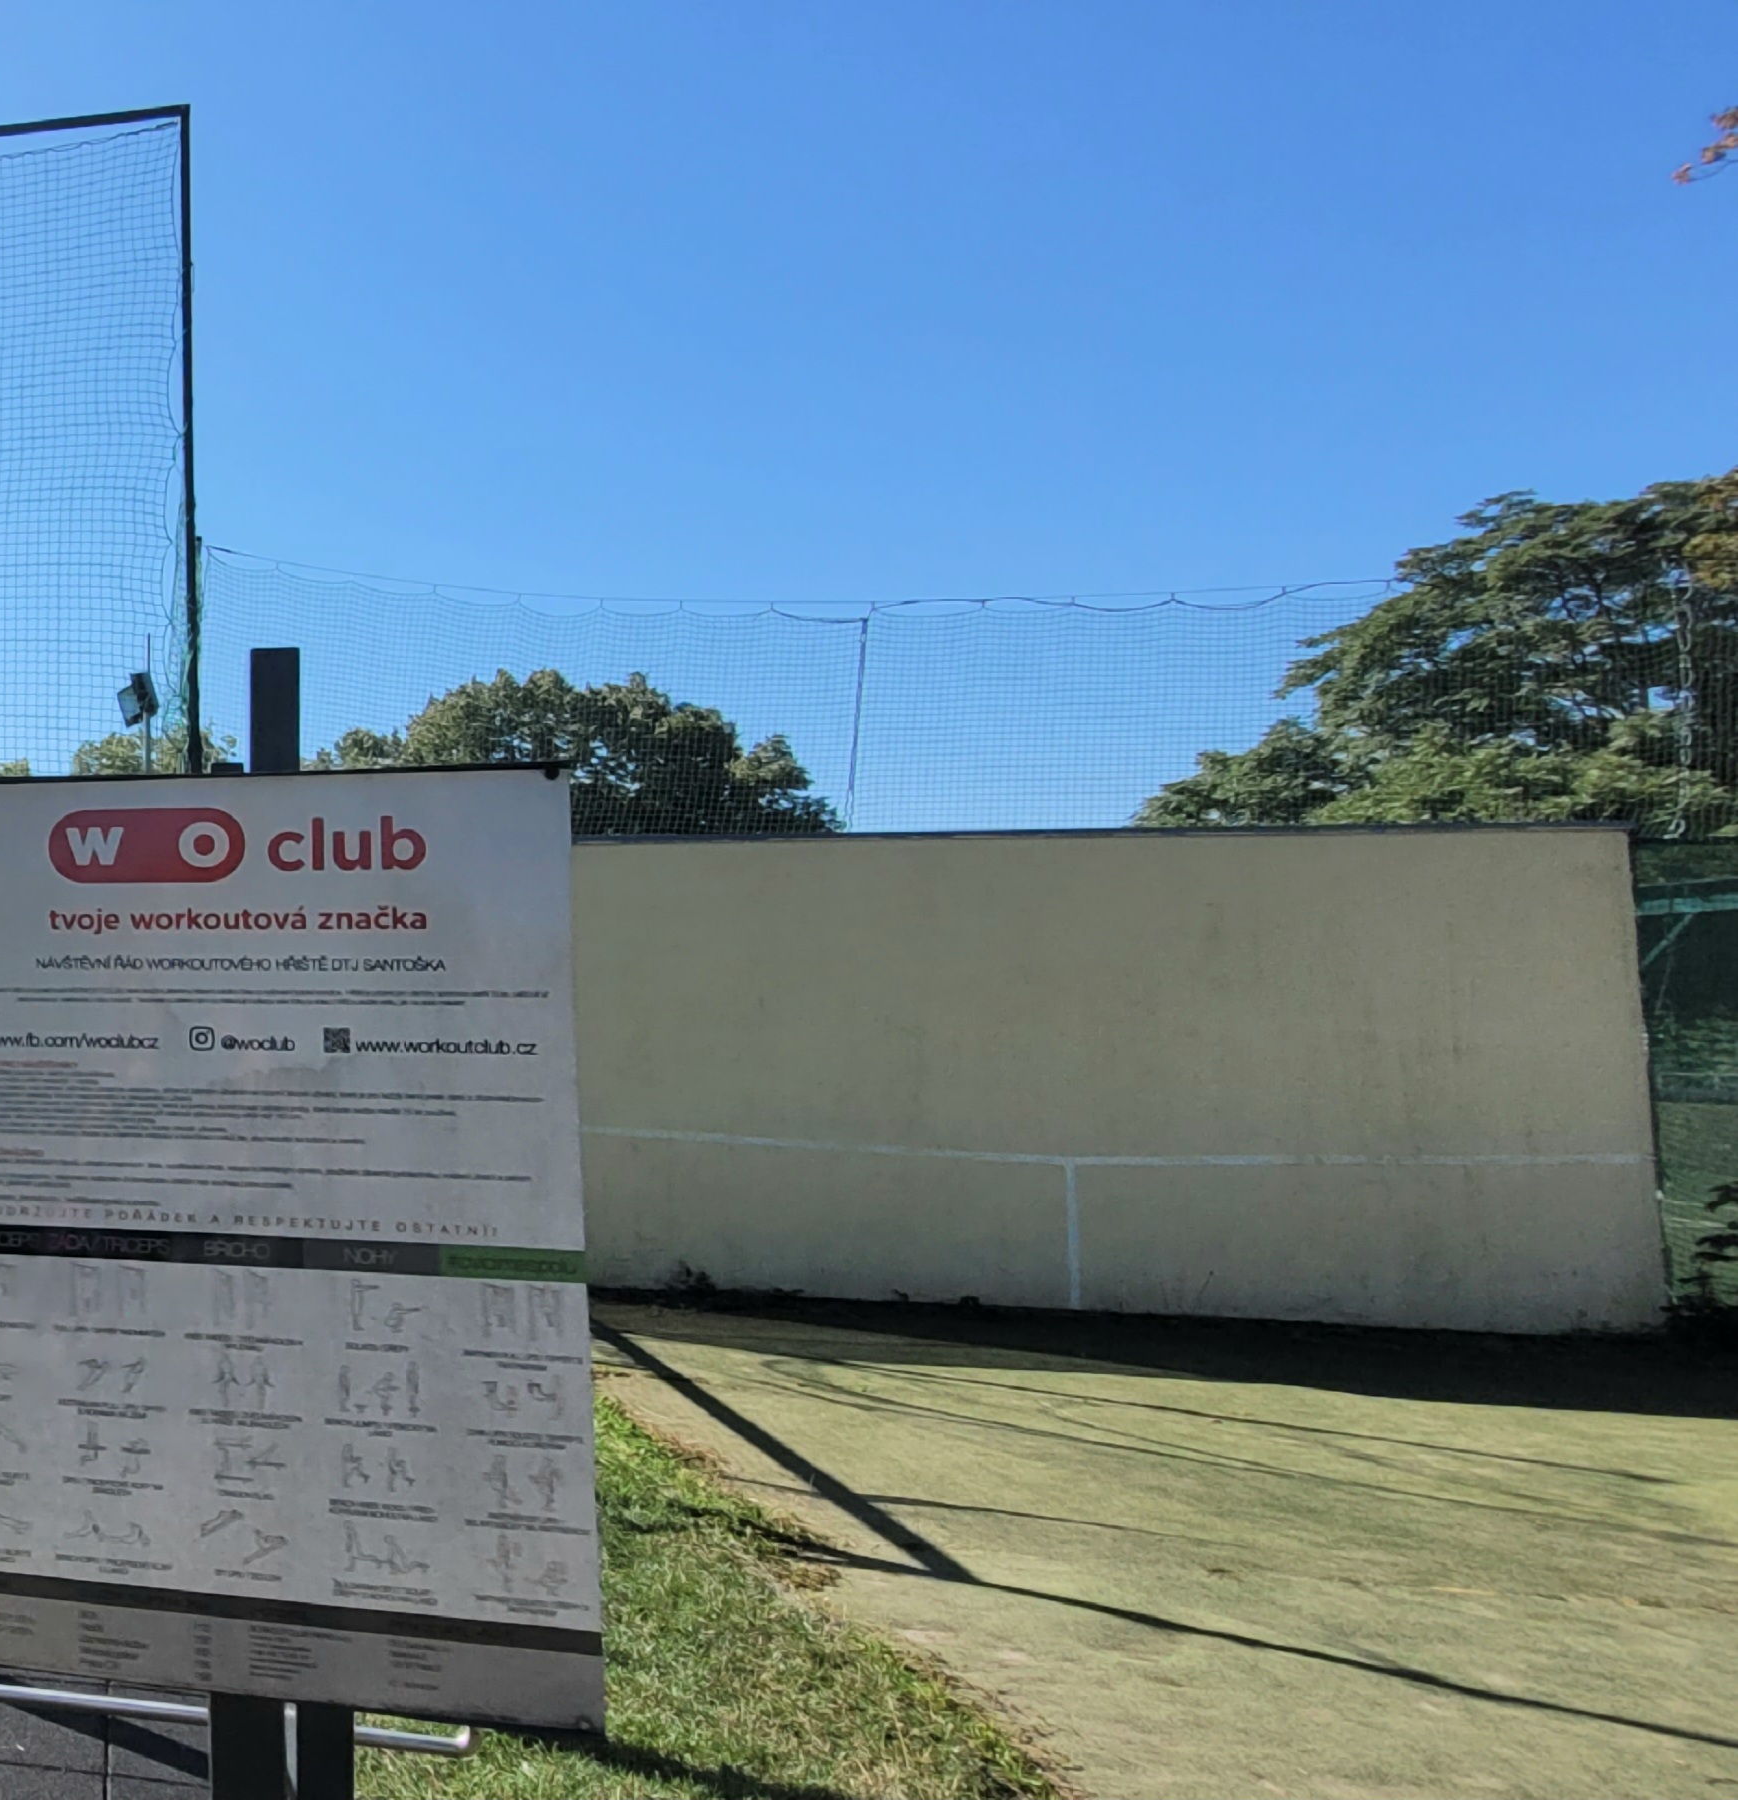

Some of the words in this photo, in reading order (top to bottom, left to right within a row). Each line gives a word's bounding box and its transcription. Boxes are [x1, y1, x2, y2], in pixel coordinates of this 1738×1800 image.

[267, 815, 427, 872] club
[49, 908, 120, 935] tvoje
[129, 905, 308, 931] workoutová
[317, 904, 428, 931] značka
[331, 957, 360, 972] DTJ
[362, 955, 447, 972] SANTOŠKA
[220, 1034, 296, 1052] @woclub
[355, 1037, 539, 1056] www.workoutclub.cz
